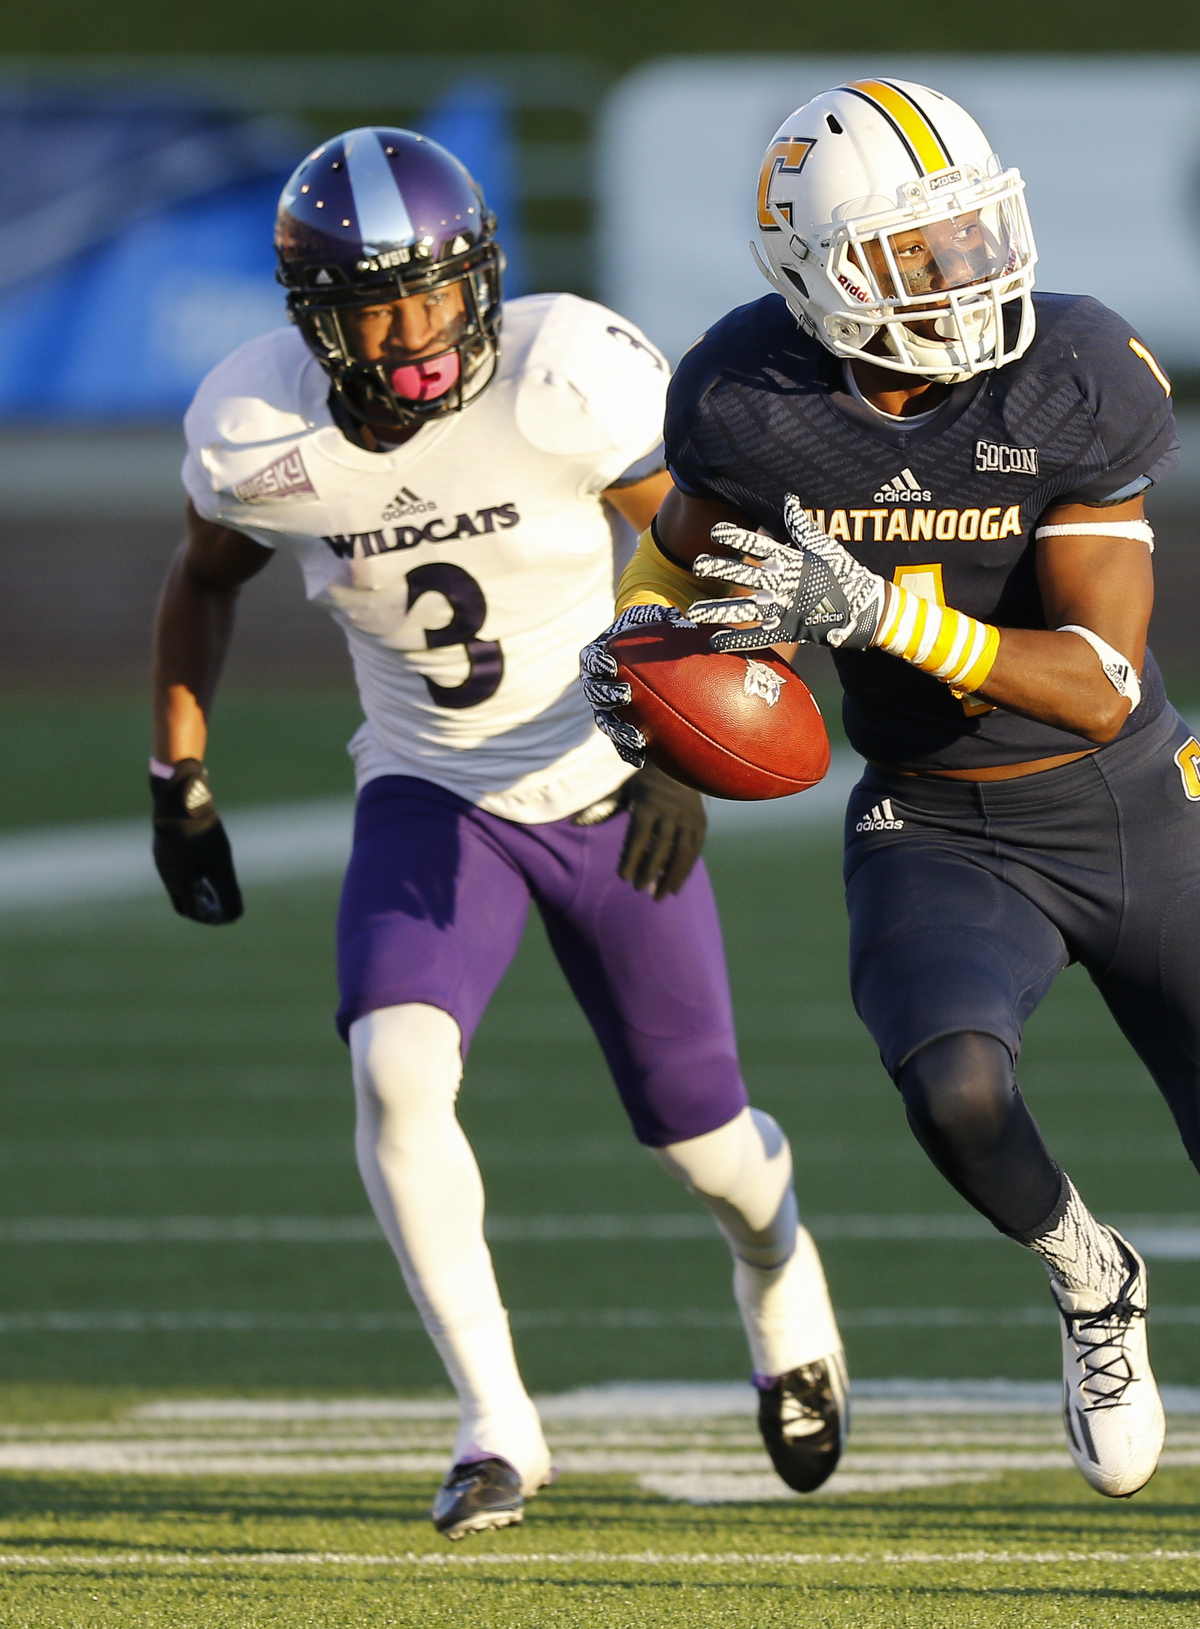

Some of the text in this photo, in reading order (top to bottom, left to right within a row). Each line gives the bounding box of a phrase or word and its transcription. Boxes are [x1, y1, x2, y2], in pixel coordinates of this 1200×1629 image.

[757, 136, 818, 232] C
[930, 170, 961, 190] MOCS
[837, 274, 883, 315] Ridd
[382, 500, 437, 521] adidas
[874, 489, 932, 503] adidas
[322, 503, 520, 559] WILDCATS
[804, 505, 1023, 541] HATTANOOGA
[404, 562, 504, 709] 3
[1105, 663, 1126, 695] adidas
[856, 819, 904, 832] adidas
